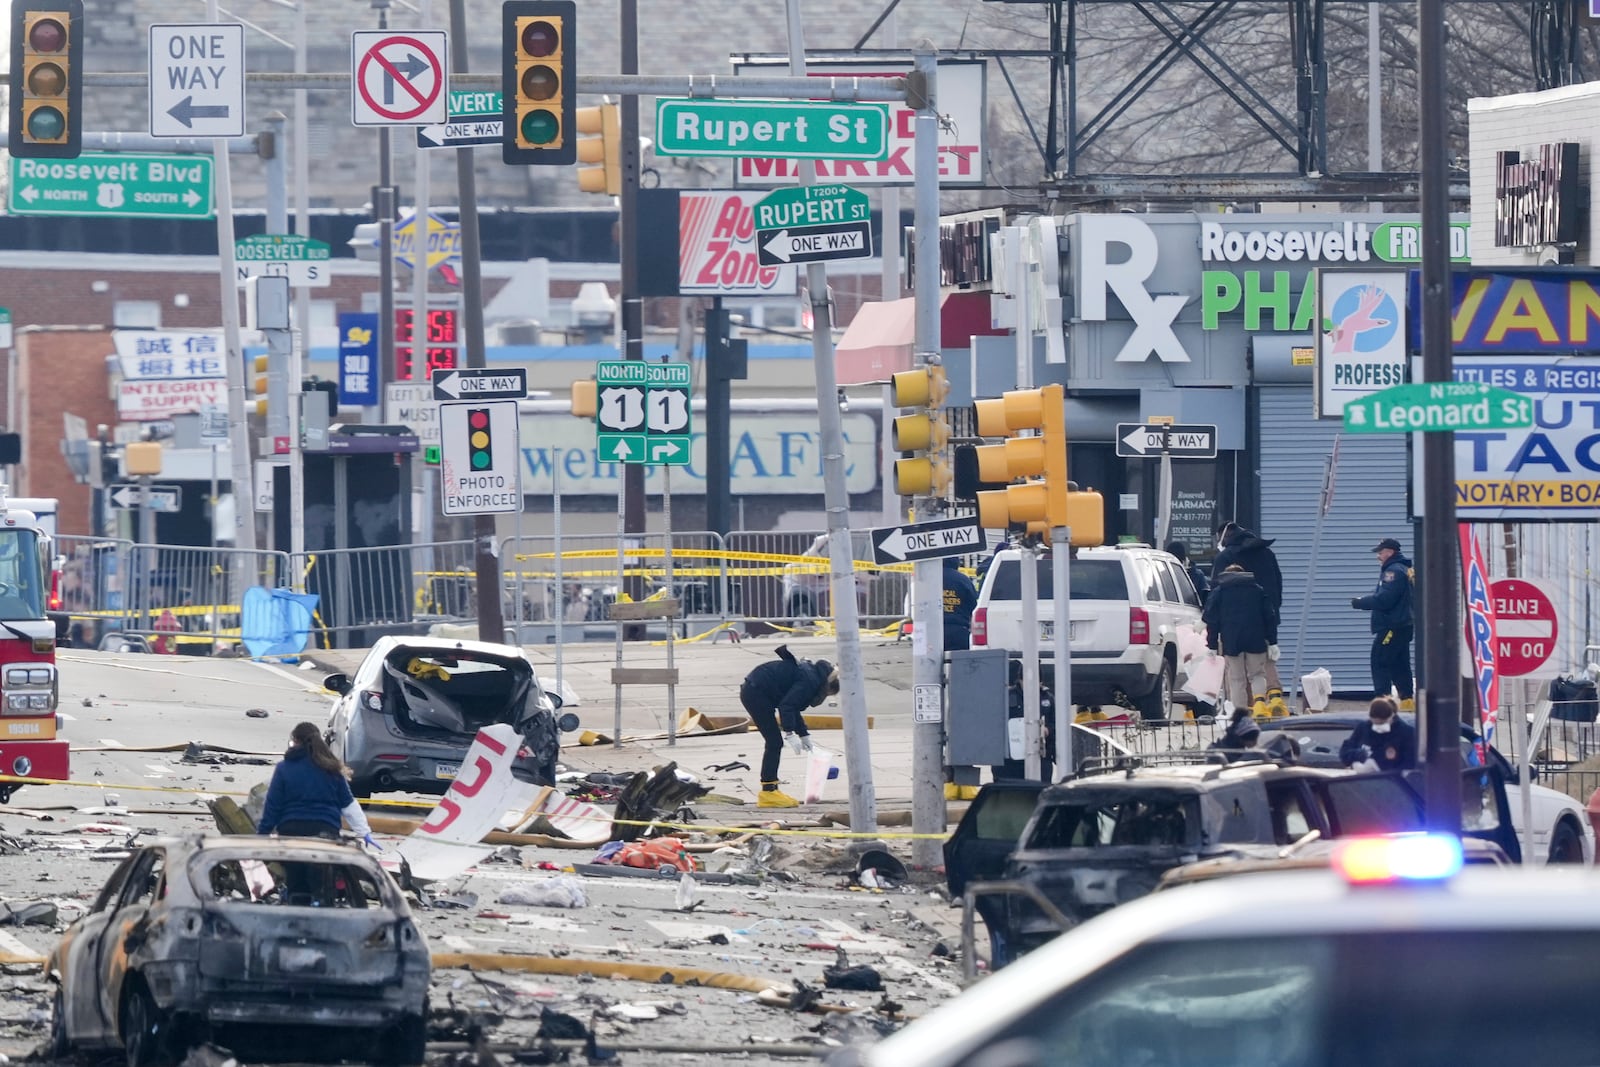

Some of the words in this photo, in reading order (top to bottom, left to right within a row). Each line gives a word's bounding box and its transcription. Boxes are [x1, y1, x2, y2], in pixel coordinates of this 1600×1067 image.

[169, 35, 225, 59] ONE
[168, 66, 226, 90] WAY
[448, 93, 496, 113] VERT
[445, 124, 470, 137] ONE
[474, 122, 501, 136] WAY
[676, 112, 808, 146] Rupert
[828, 114, 868, 144] St
[19, 158, 139, 181] Roosevelt
[148, 162, 202, 183] Blvd
[43, 190, 88, 201] NORTH
[134, 192, 178, 204] SOUTH
[813, 186, 838, 197] 7200
[760, 198, 846, 227] RUPERT
[851, 204, 866, 218] ST
[791, 235, 822, 252] ONE
[827, 233, 858, 250] WAY
[1202, 221, 1370, 262] Roosevelt
[236, 244, 305, 260] OOSEVELT
[238, 267, 248, 280] N
[307, 266, 318, 279] S
[1081, 215, 1192, 362] Rx
[601, 364, 644, 380] NORTH
[1523, 368, 1537, 387] &
[121, 381, 228, 395] INTEGRIT
[461, 378, 485, 391] ONE
[491, 377, 516, 390] WAY
[1431, 385, 1443, 399] N
[141, 395, 217, 407] SUPPLY
[615, 394, 627, 423] 1
[399, 408, 437, 421] MUST
[658, 395, 671, 425] 1
[1374, 397, 1490, 428] Leonard
[1501, 398, 1530, 424] St
[421, 428, 439, 440] LEF
[1178, 434, 1205, 447] WAY
[460, 476, 504, 490] PHOTO
[449, 493, 516, 508] ENFORCED
[1455, 483, 1544, 503] NOTARY
[1171, 500, 1216, 509] HARMACY
[906, 533, 937, 550] ONE
[942, 528, 973, 545] WAY
[1493, 598, 1538, 615] ENTE
[1521, 643, 1544, 658] DO
